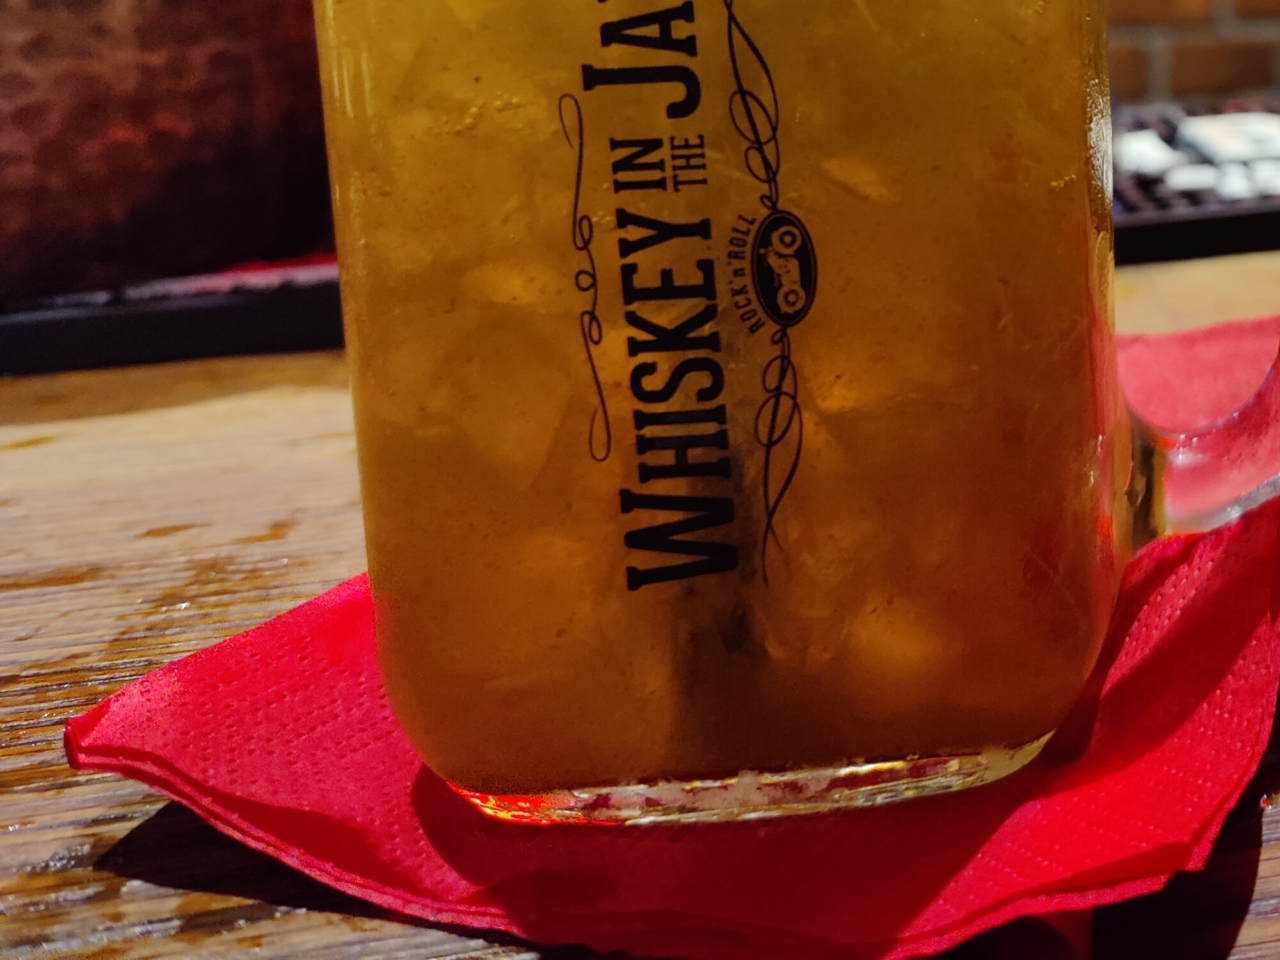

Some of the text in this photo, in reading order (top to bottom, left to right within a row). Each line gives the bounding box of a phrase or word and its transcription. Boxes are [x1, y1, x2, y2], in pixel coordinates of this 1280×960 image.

[609, 137, 668, 193] IN
[670, 133, 708, 192] THE
[615, 208, 739, 591] WHISKEY
